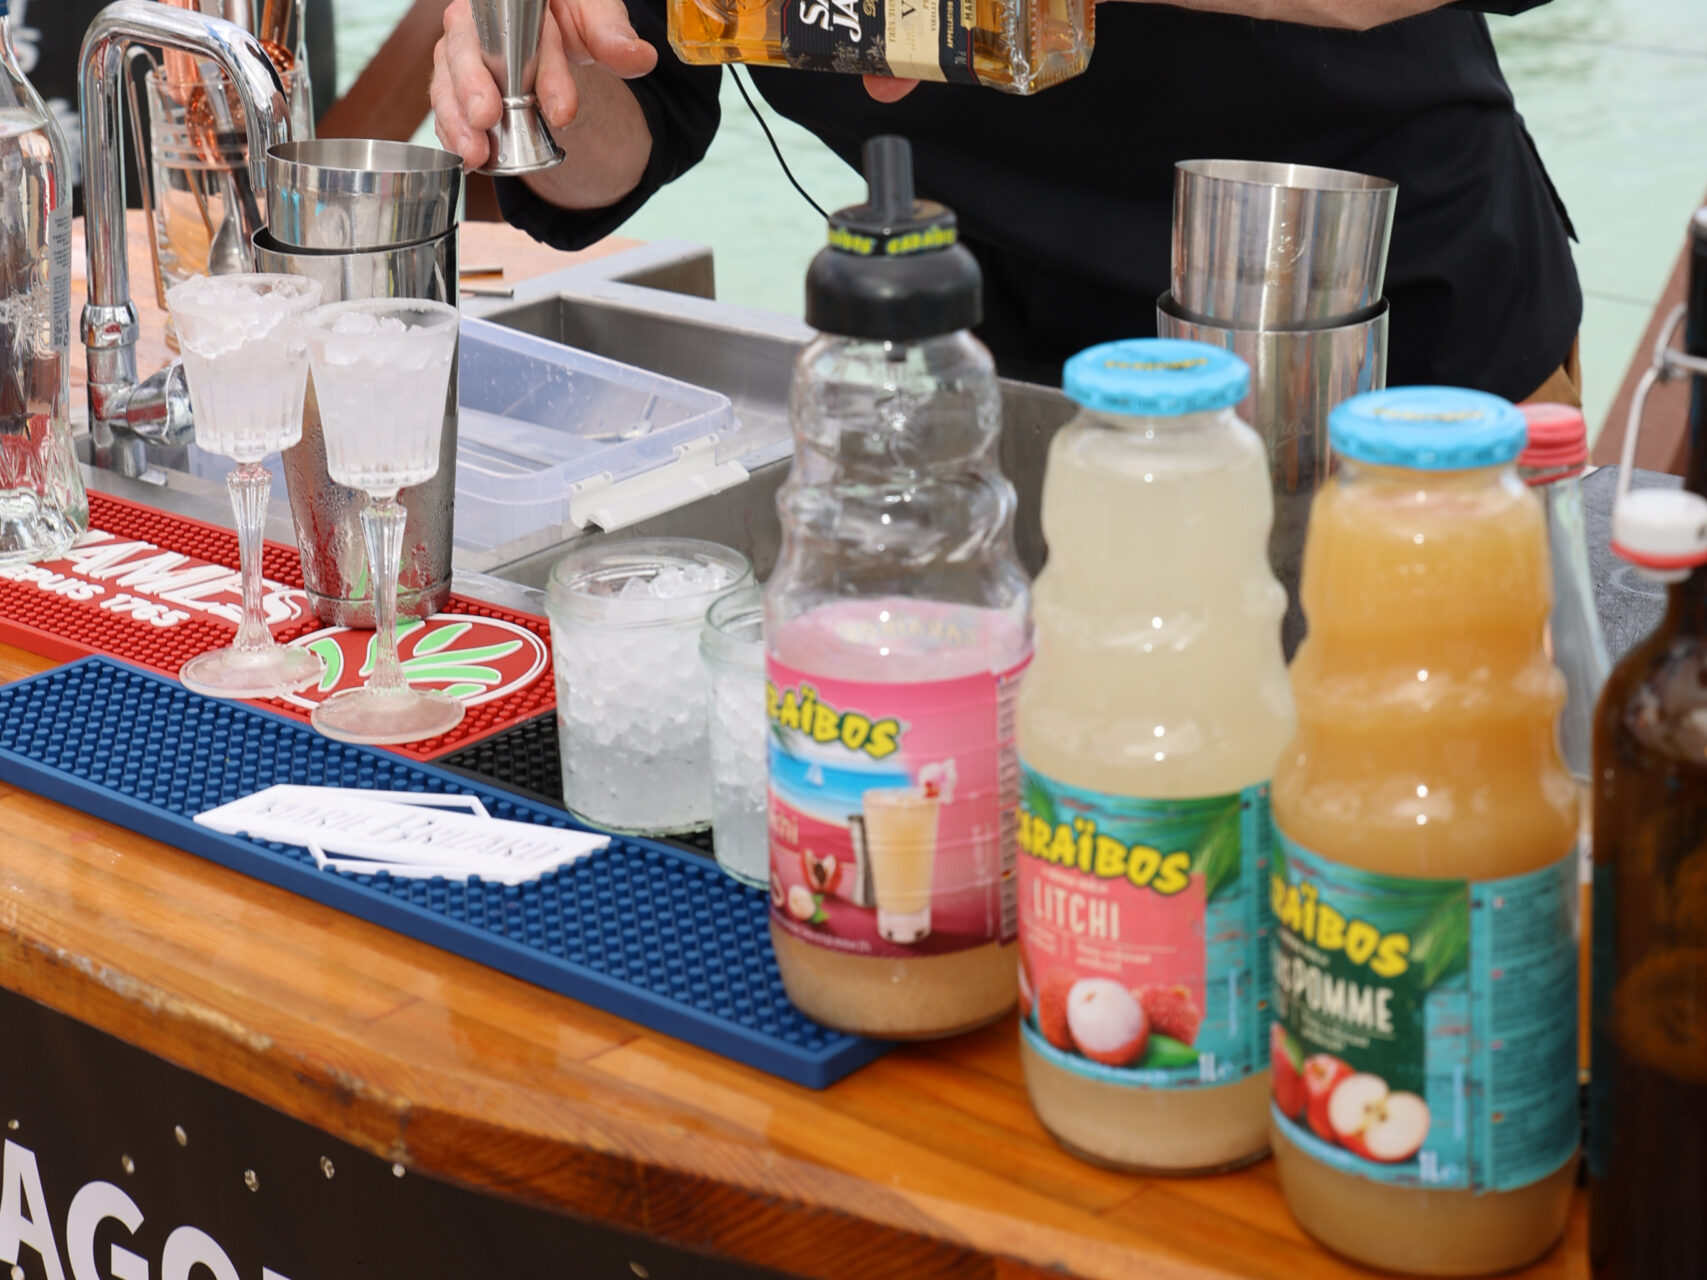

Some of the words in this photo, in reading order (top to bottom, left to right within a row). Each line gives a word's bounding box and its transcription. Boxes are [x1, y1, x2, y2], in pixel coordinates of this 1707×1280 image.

[946, 2, 954, 48] APPELLATION
[100, 593, 190, 627] 1765
[1033, 876, 1120, 942] LITCHI
[1291, 955, 1395, 1034] POMME
